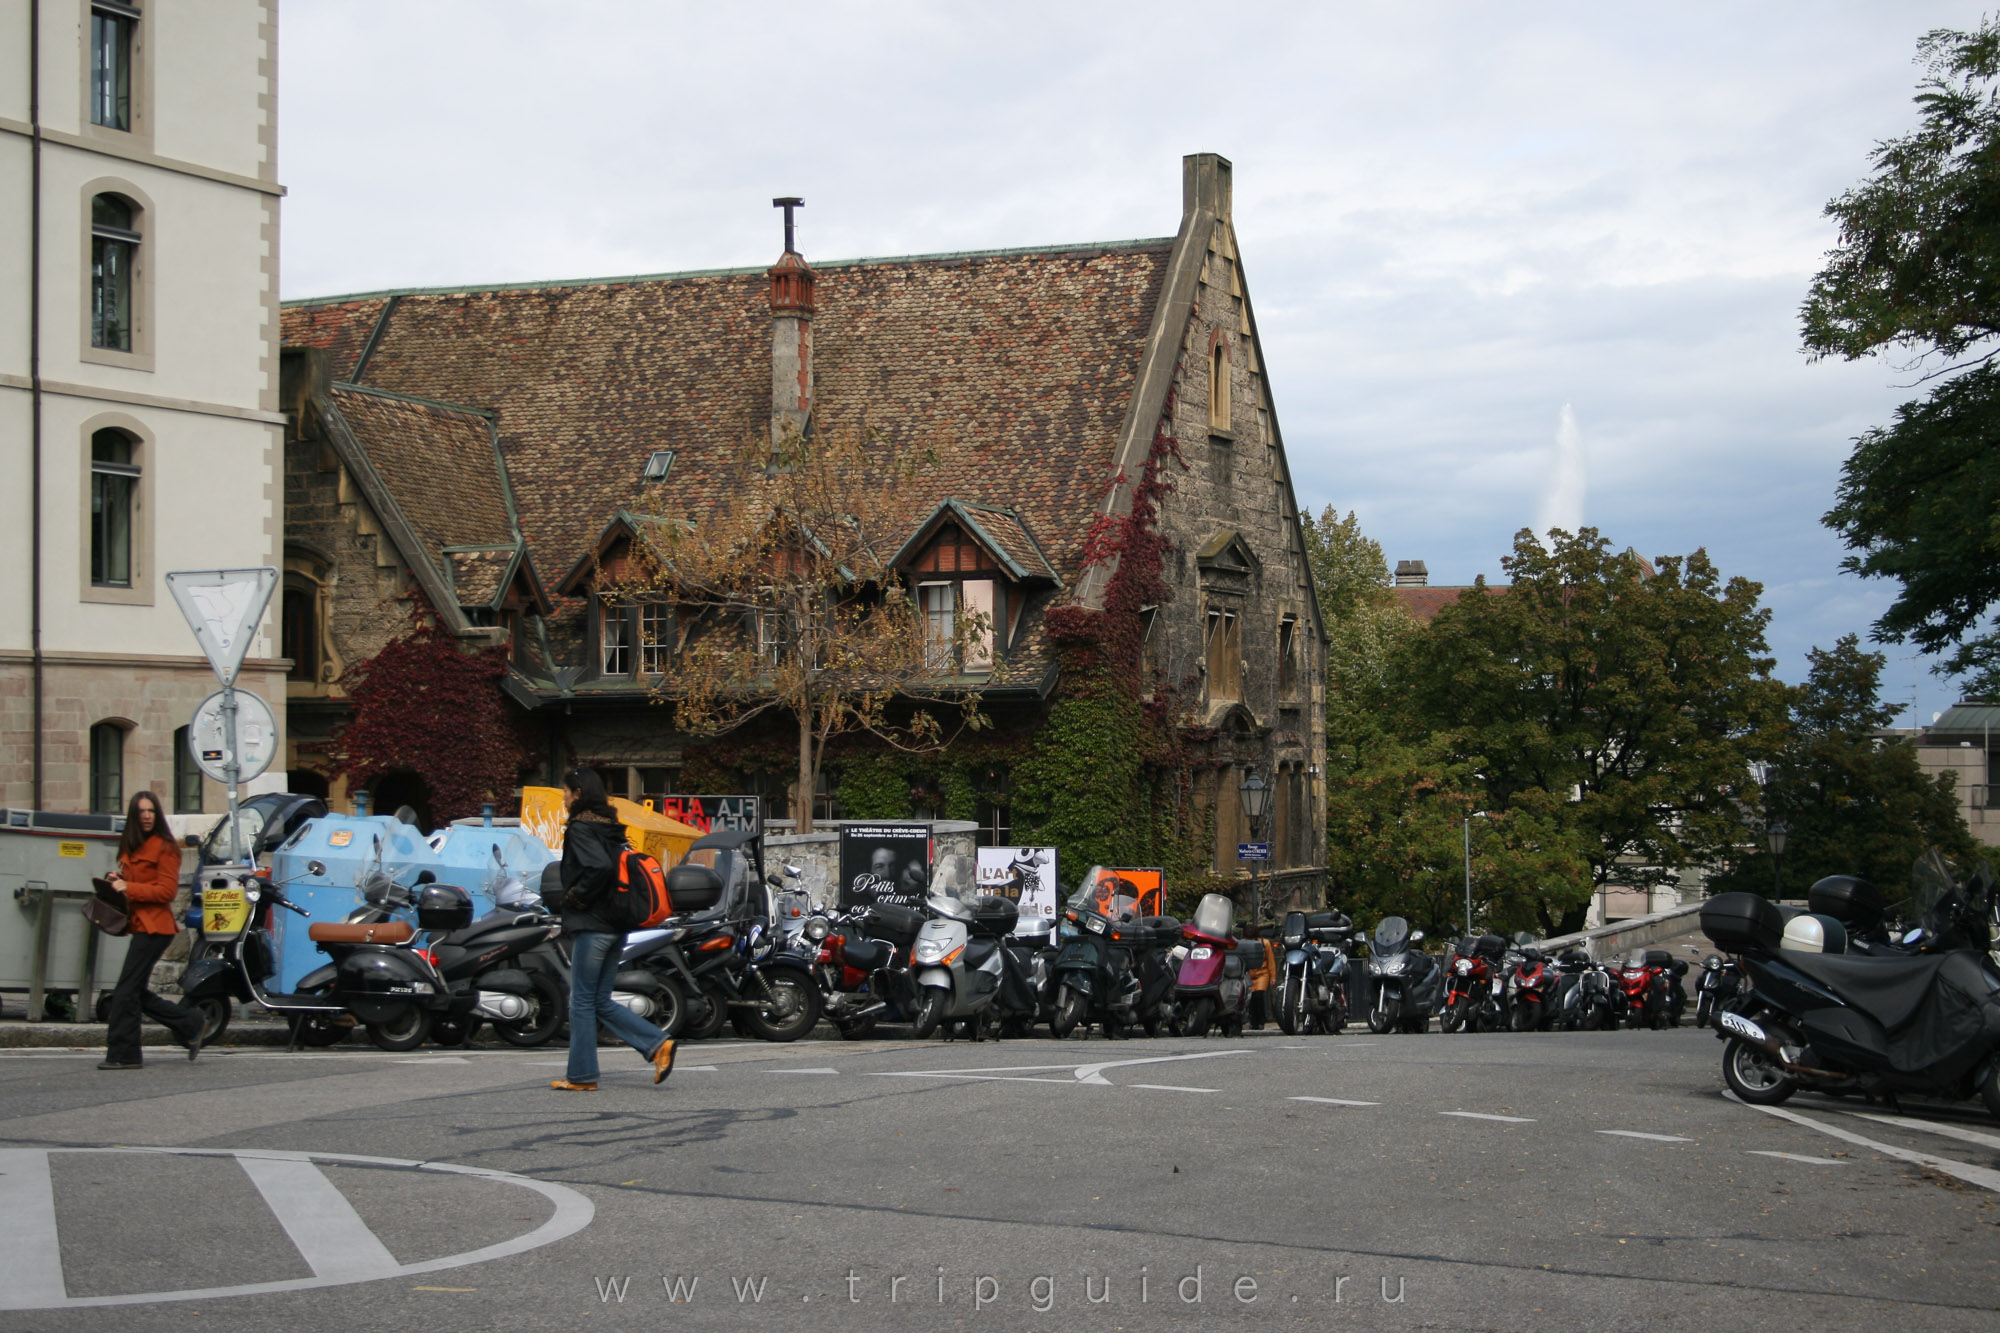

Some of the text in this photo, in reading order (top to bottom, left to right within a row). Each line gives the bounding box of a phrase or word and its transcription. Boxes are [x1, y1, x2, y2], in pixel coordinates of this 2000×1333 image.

[664, 798, 705, 817] FLA
[982, 867, 1019, 880] L'Art
[852, 872, 895, 893] Petits
[983, 885, 1019, 897] de la
